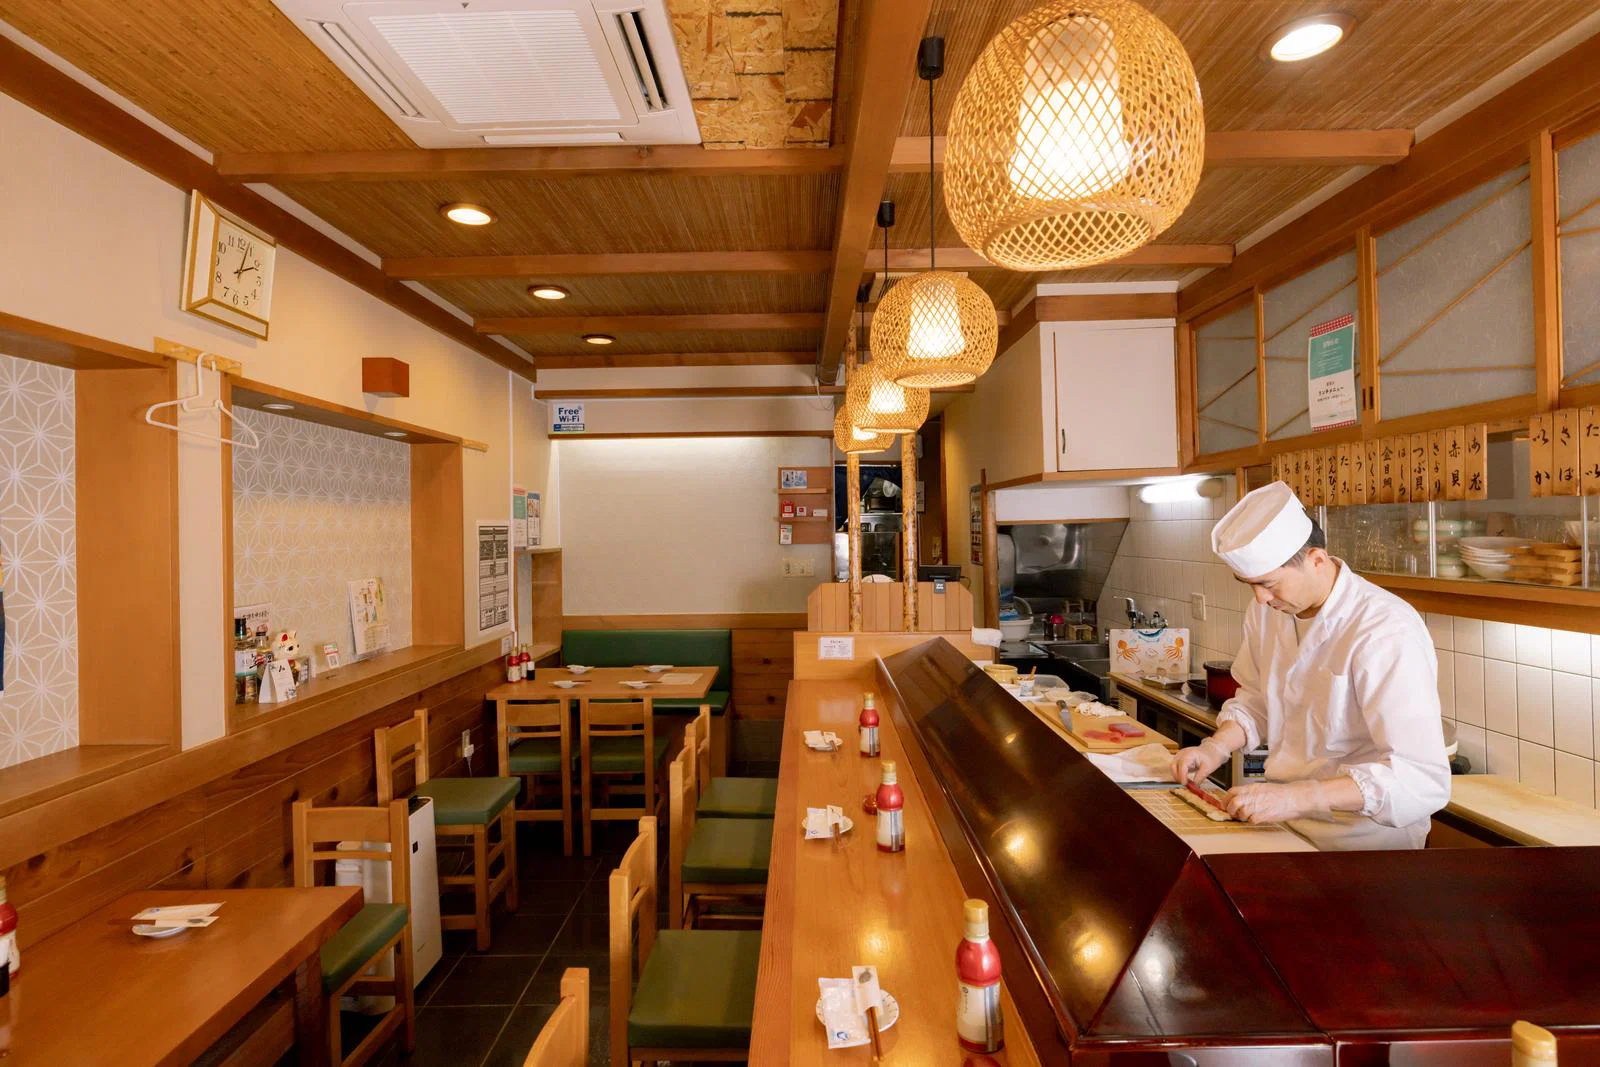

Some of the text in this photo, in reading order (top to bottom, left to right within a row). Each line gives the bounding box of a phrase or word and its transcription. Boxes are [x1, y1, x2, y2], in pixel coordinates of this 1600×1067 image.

[218, 241, 226, 254] 10
[237, 237, 246, 251] 12
[215, 271, 222, 284] 8
[223, 286, 230, 297] 7
[232, 294, 239, 305] 6
[243, 295, 249, 306] 5
[558, 407, 579, 415] Free
[1558, 426, 1574, 482] さば
[1412, 447, 1426, 490] つぶ貝
[1449, 440, 1461, 487] 赤貝
[1355, 455, 1363, 493] うに
